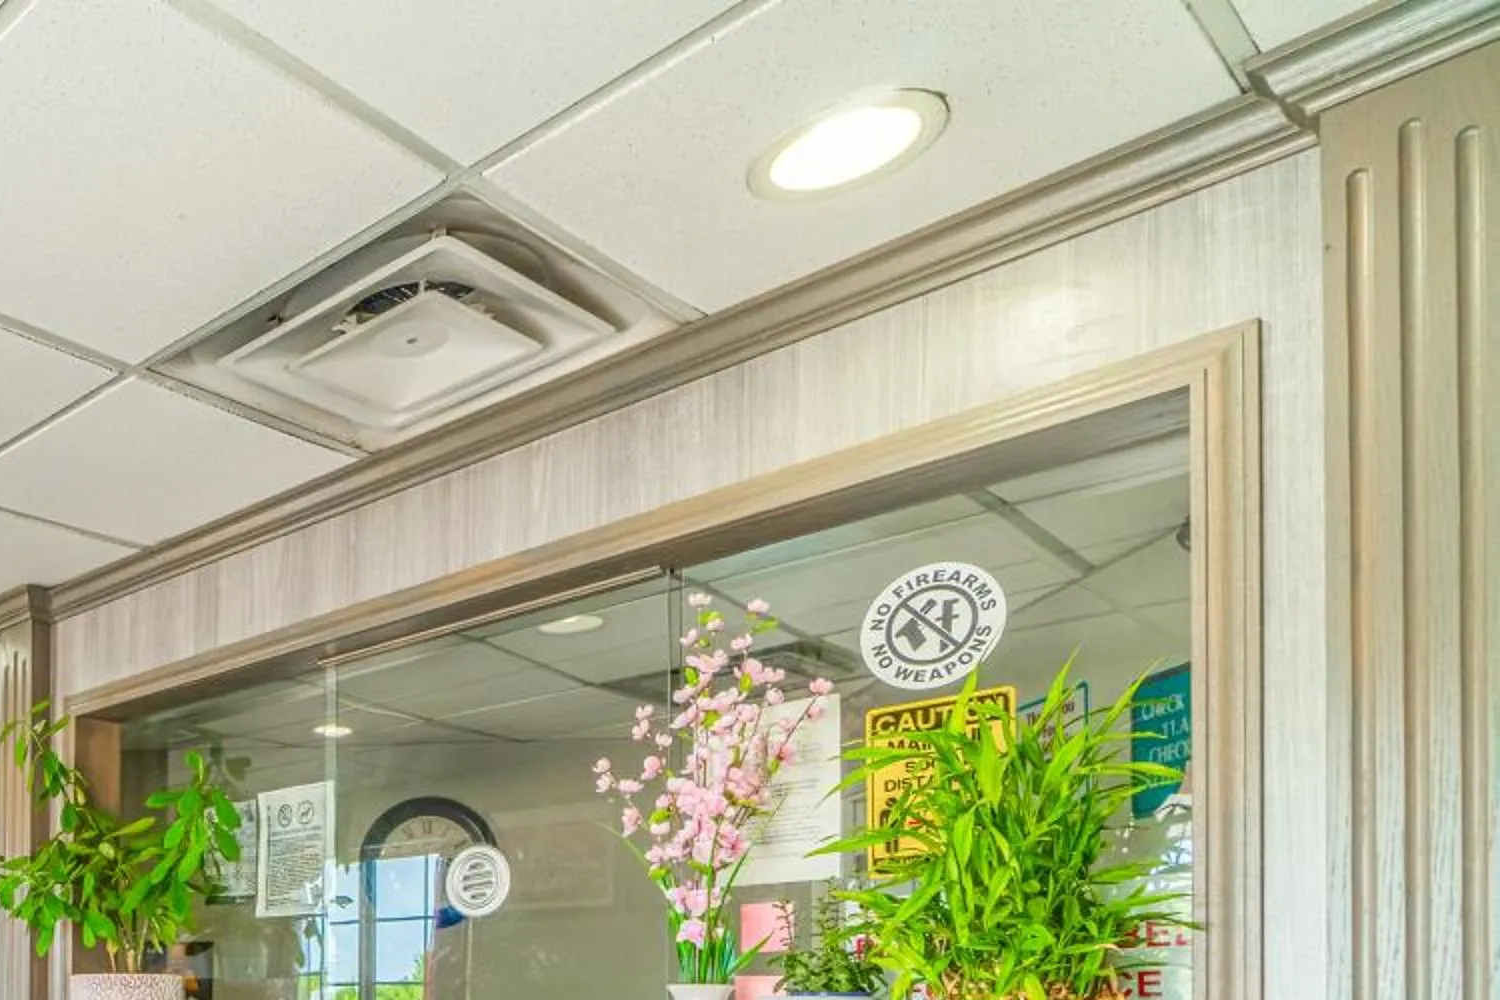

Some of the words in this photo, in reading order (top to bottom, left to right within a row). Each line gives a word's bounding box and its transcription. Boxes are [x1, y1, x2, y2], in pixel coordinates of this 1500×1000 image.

[869, 602, 891, 631] NO
[892, 569, 997, 611] FIREARMS
[871, 643, 893, 669] NO
[894, 624, 992, 683] WEAPONS
